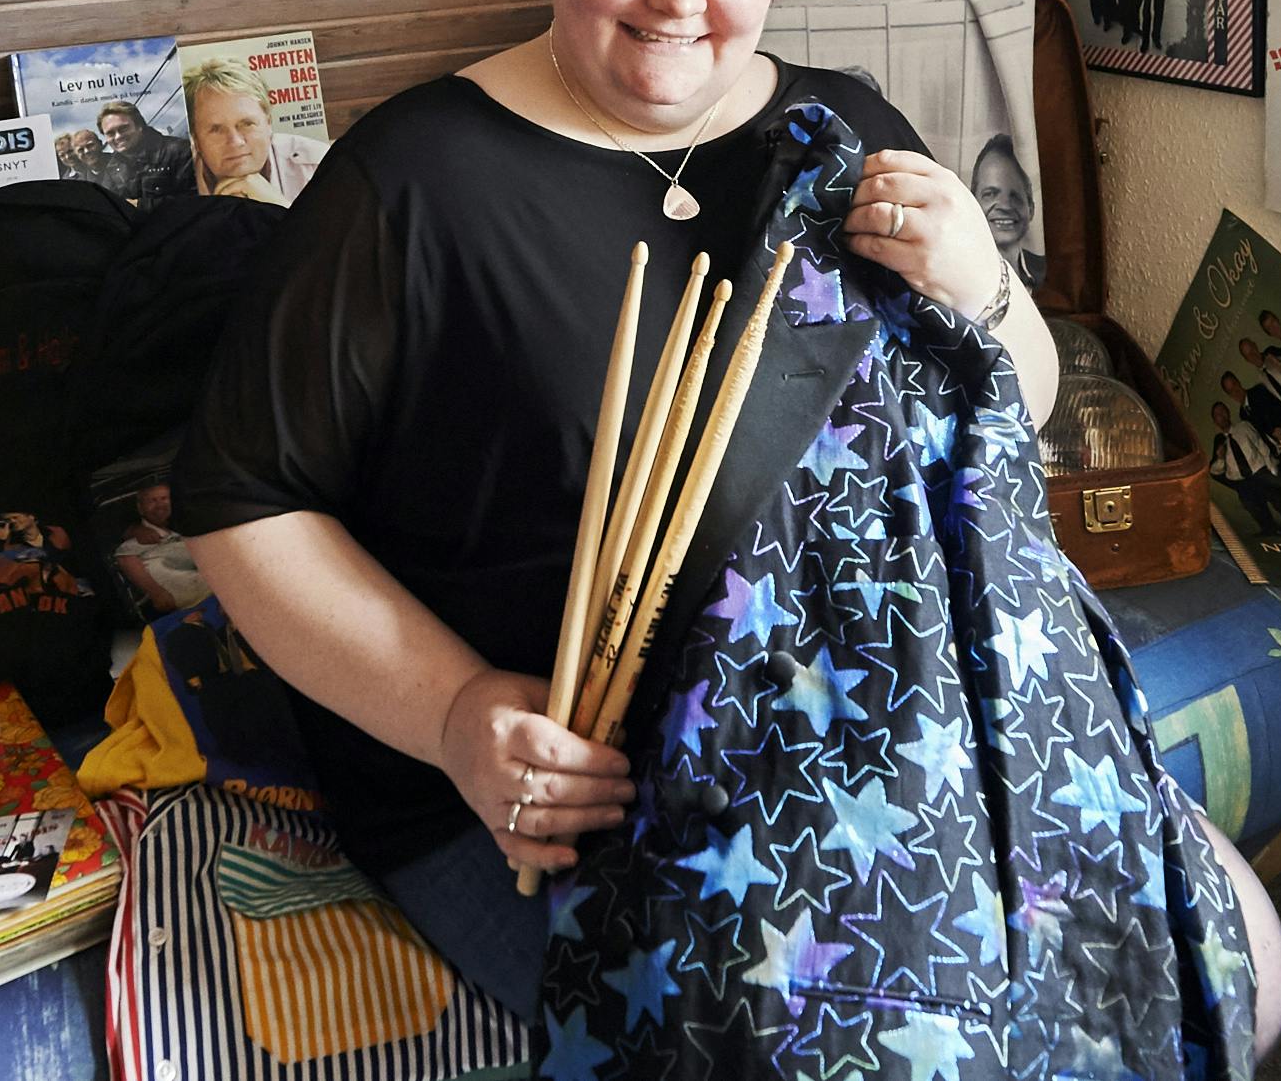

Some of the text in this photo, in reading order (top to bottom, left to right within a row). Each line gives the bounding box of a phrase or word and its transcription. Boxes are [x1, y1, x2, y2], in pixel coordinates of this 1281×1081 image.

[248, 49, 314, 71] SMERTEN
[59, 73, 140, 93] Lev nu livet
[290, 66, 316, 84] BAG
[268, 85, 318, 105] SMILET
